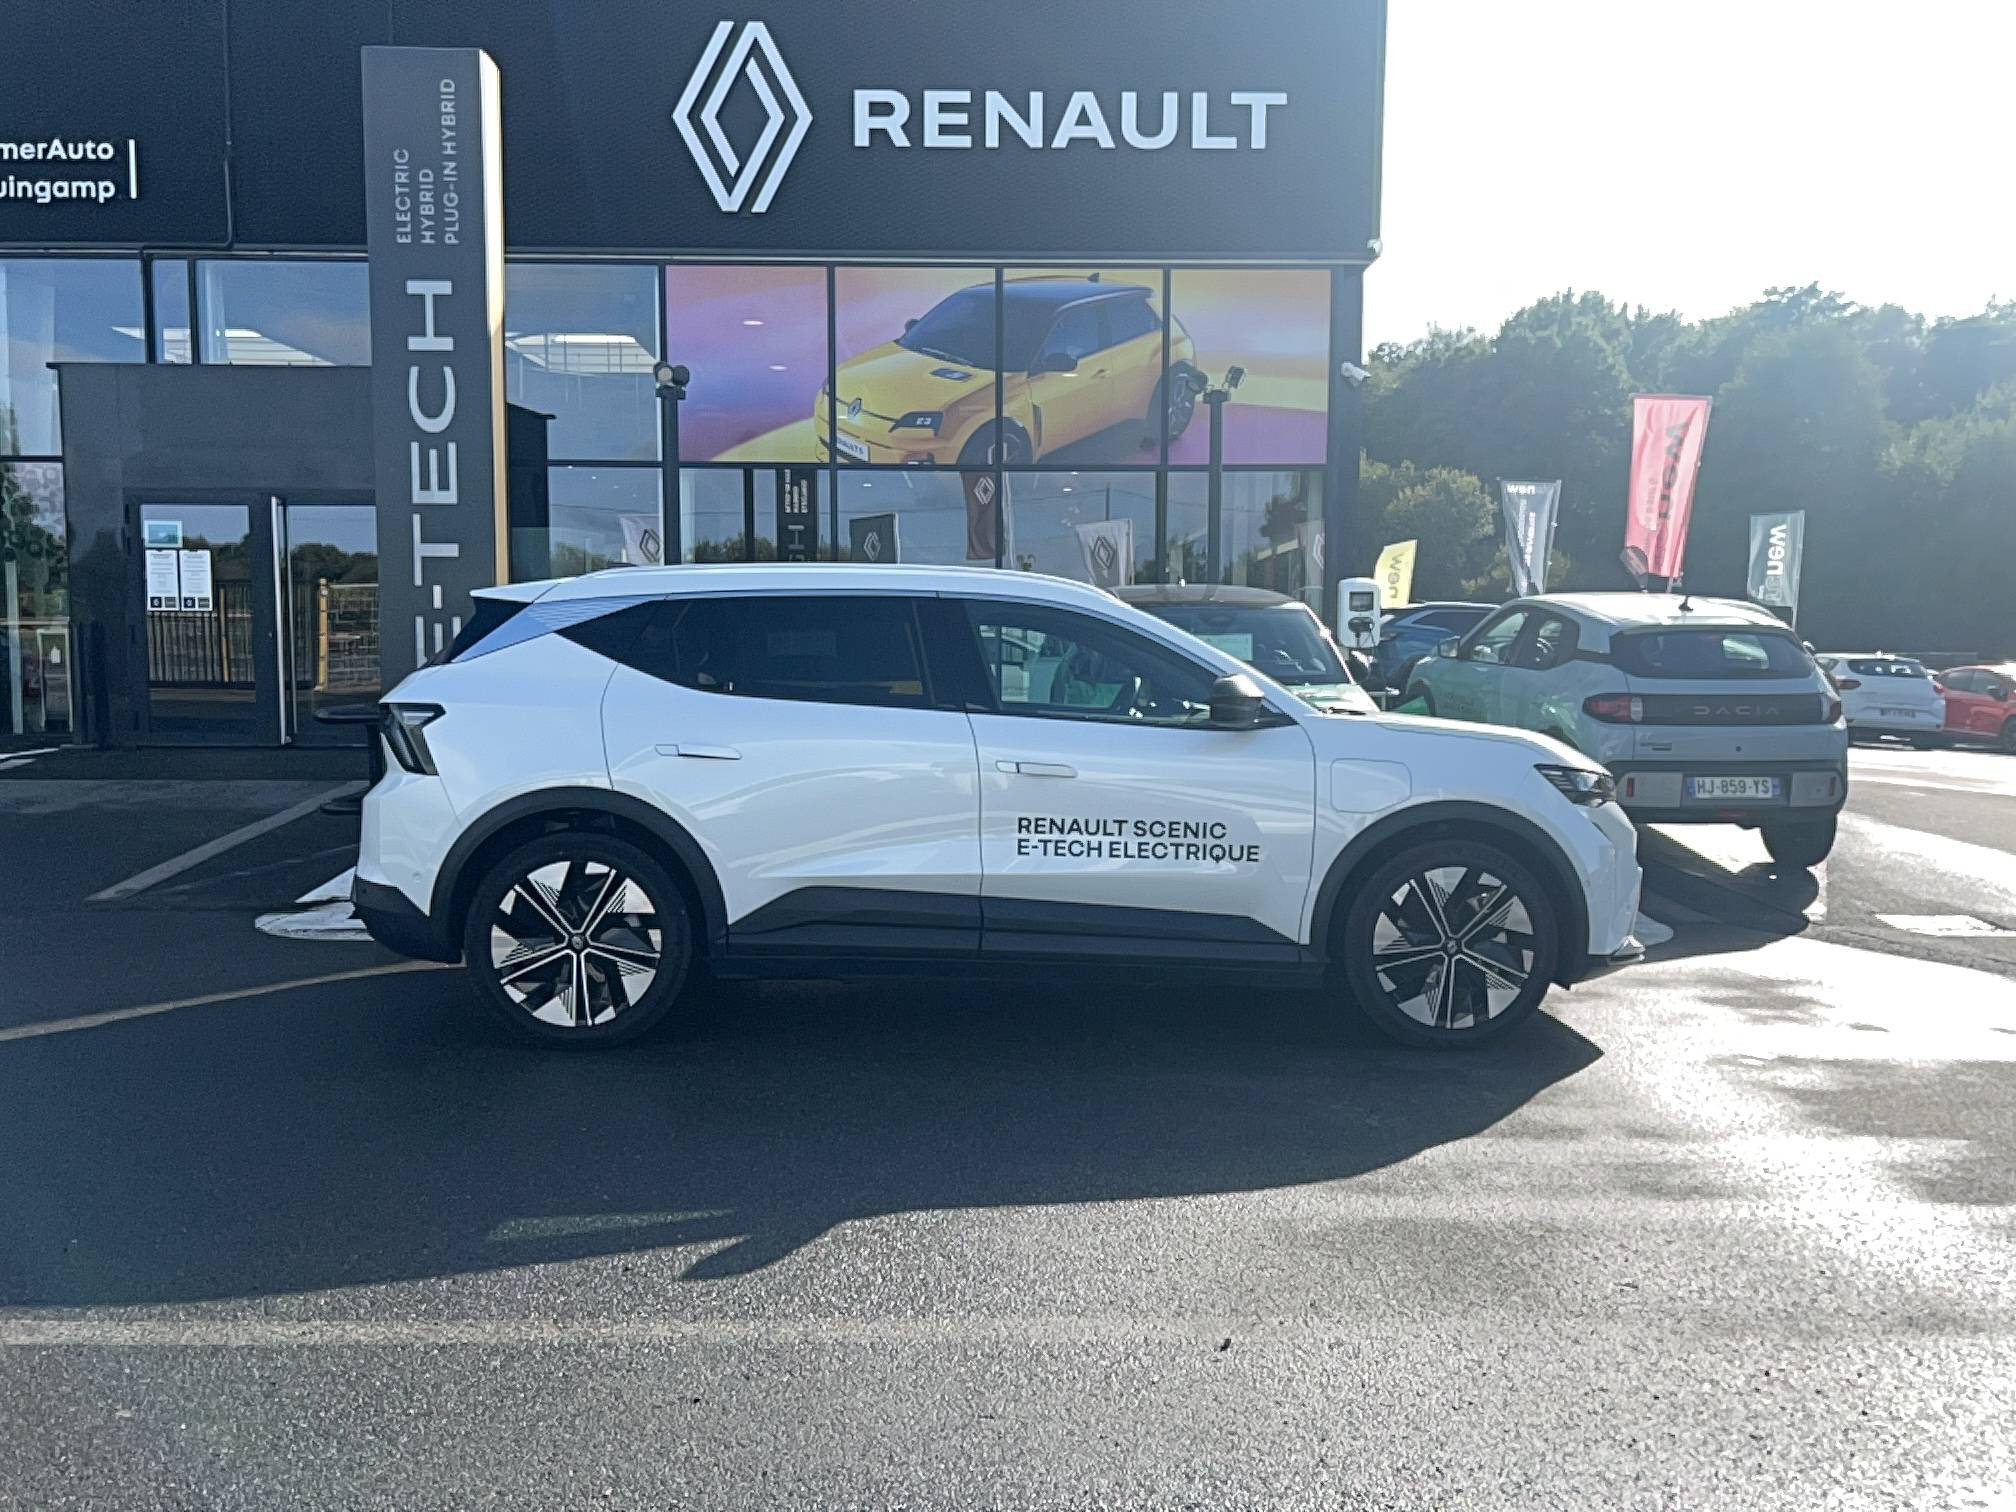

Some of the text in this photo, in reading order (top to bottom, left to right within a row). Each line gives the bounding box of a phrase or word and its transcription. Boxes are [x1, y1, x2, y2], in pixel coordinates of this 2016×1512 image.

[853, 88, 1288, 150] RENAULT
[440, 79, 460, 244] PLUG-IN HYBRID
[393, 148, 412, 244] ELECTRIC
[418, 168, 435, 244] HYBRID
[1387, 551, 1405, 599] wen
[1693, 705, 1779, 715] DACIA
[1696, 778, 1771, 794] HJ-859-YS
[1016, 838, 1261, 864] E-TECH ELECTRIQUE
[1017, 816, 1227, 839] RENAULT SCENIC
